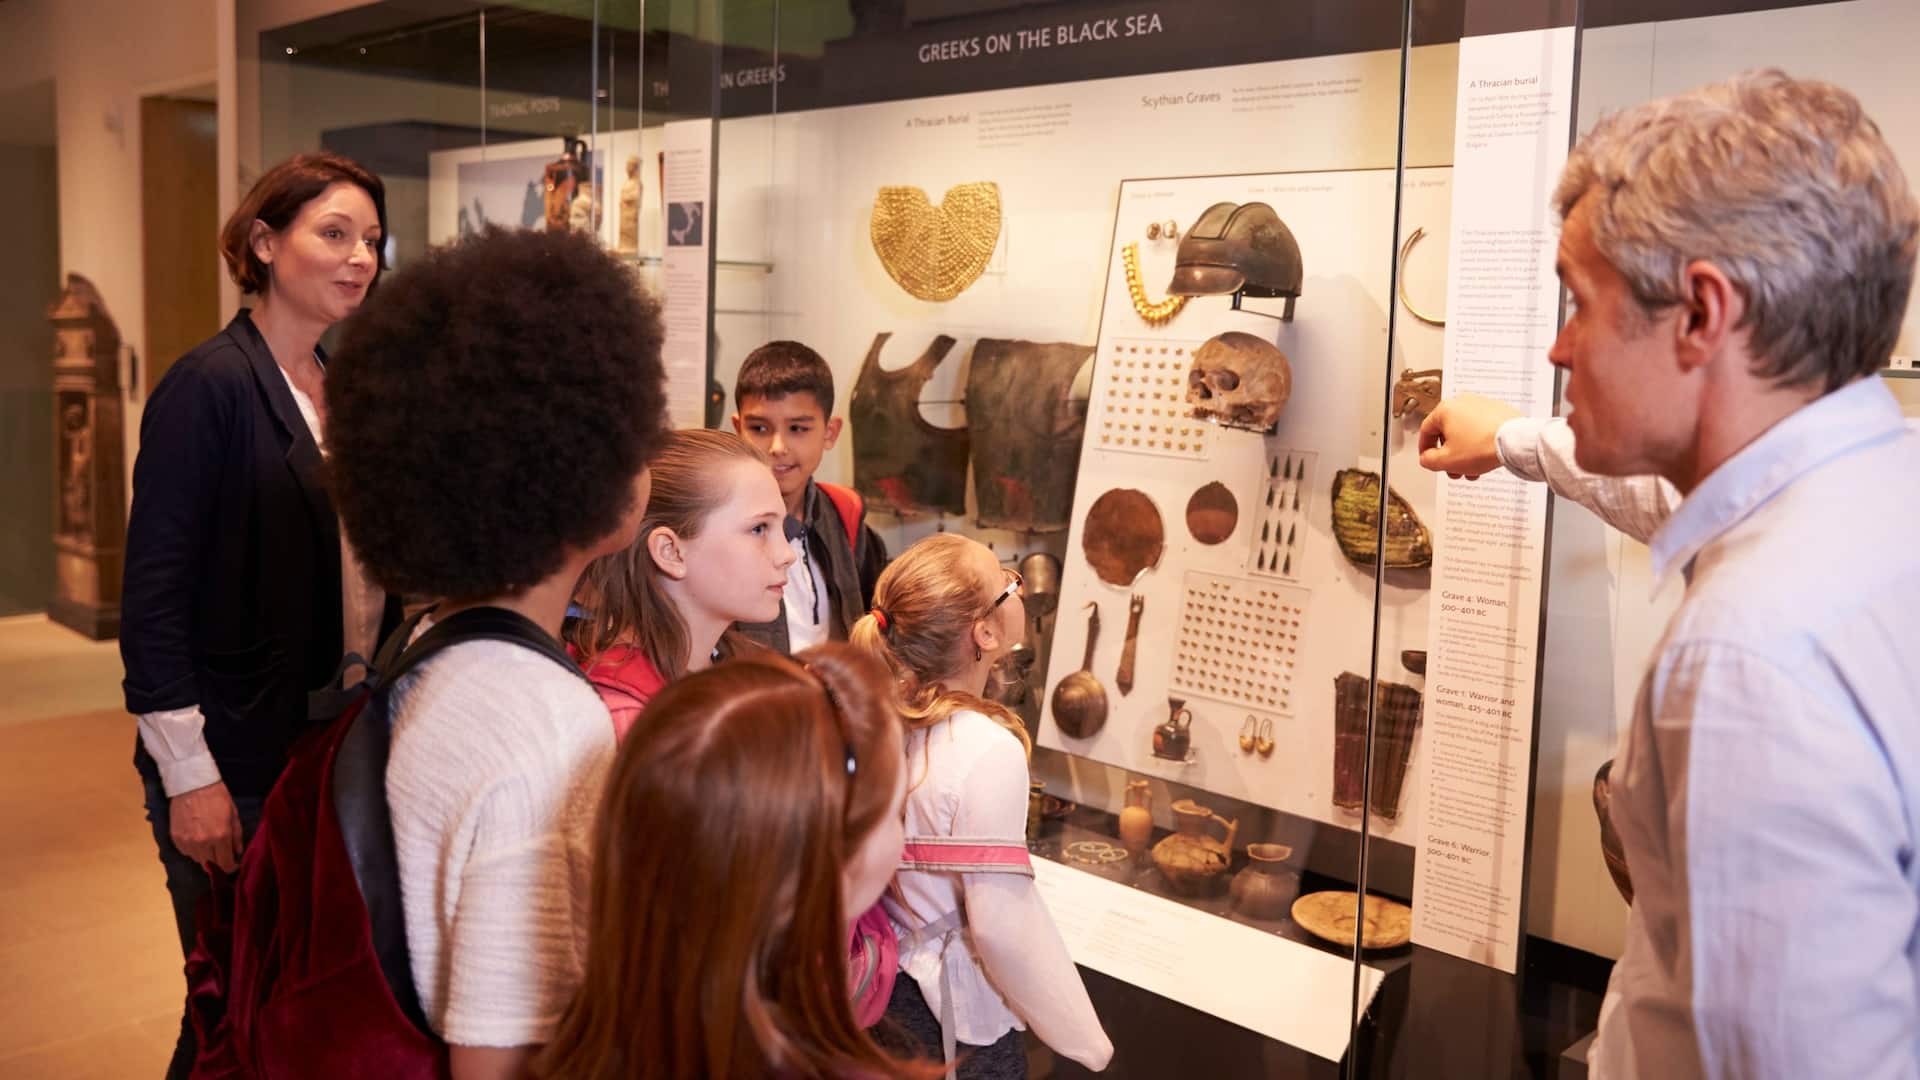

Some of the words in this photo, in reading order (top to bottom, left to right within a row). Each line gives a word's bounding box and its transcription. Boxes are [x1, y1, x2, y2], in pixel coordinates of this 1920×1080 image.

[919, 37, 981, 63] GREEKS
[985, 34, 1011, 54] ON
[1017, 28, 1051, 49] THE
[1057, 19, 1118, 45] BLACK
[1125, 14, 1162, 37] SEA
[736, 65, 786, 87] GREEKS
[1479, 80, 1512, 88] Thracian
[1141, 93, 1184, 111] Scythian
[1186, 91, 1221, 104] Graves
[1441, 590, 1464, 601] Grave
[1436, 684, 1459, 696] Grave
[1469, 690, 1498, 703] Warrior
[1501, 698, 1515, 706] and
[1427, 834, 1450, 846] Grave
